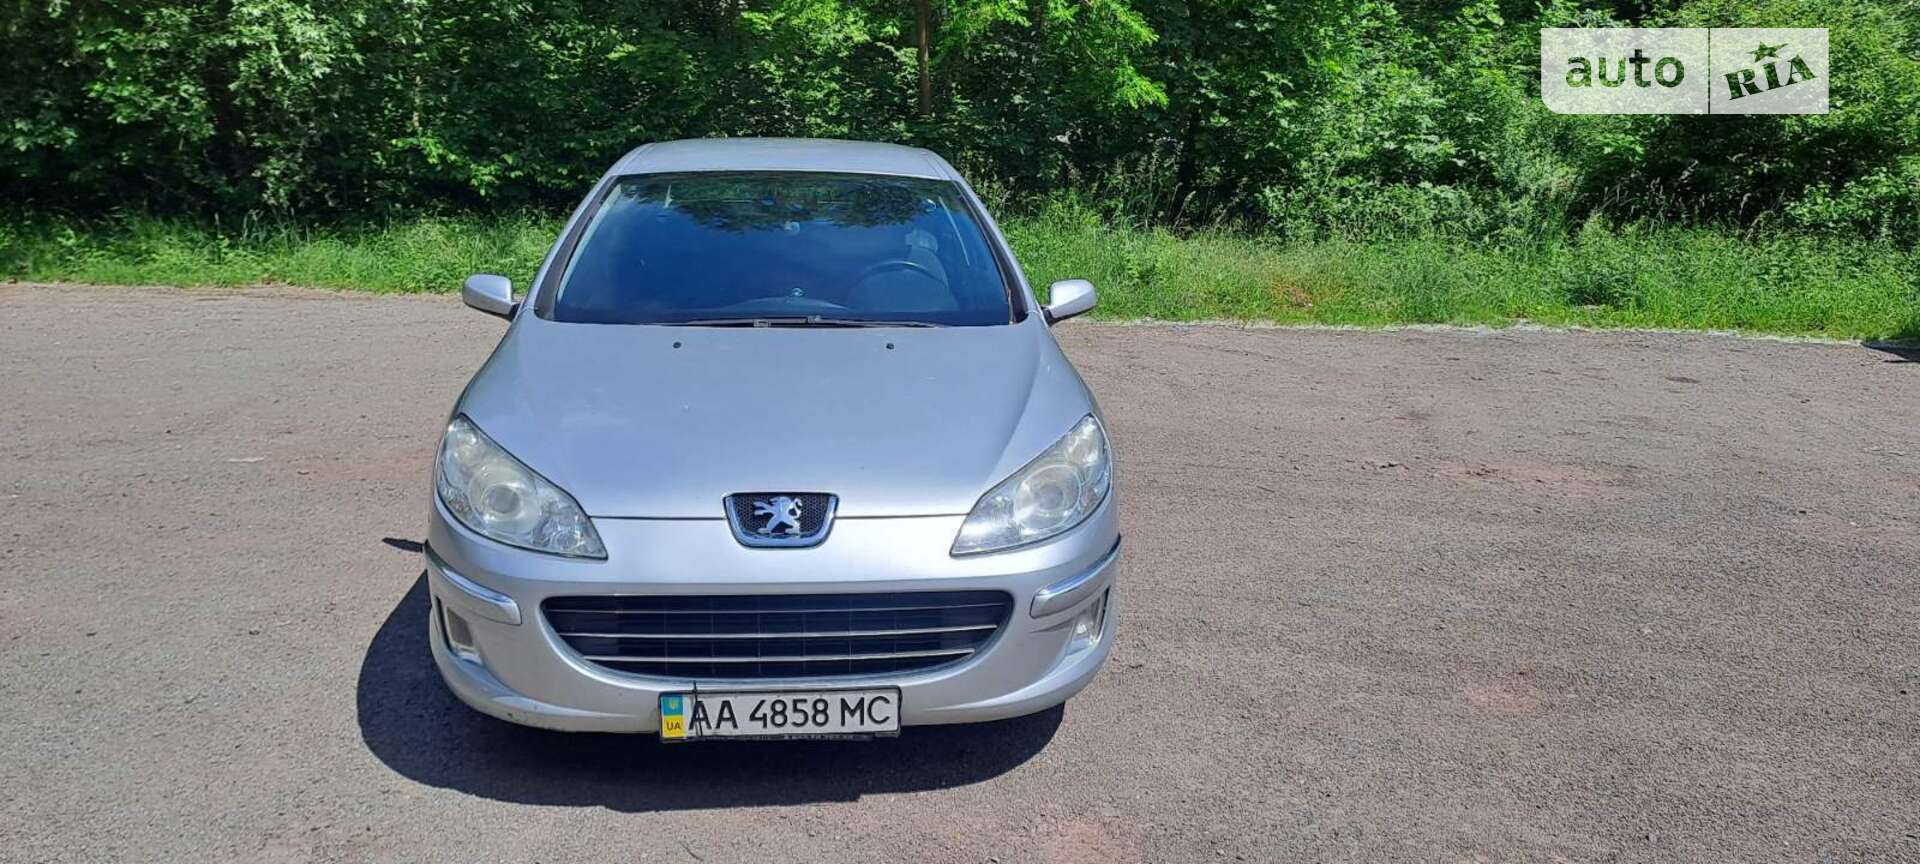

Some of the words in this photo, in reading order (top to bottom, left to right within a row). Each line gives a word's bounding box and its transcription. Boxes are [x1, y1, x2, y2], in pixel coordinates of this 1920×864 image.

[688, 700, 739, 730] AA
[750, 699, 830, 728] 4858
[840, 695, 890, 727] MC
[666, 721, 682, 731] UA
